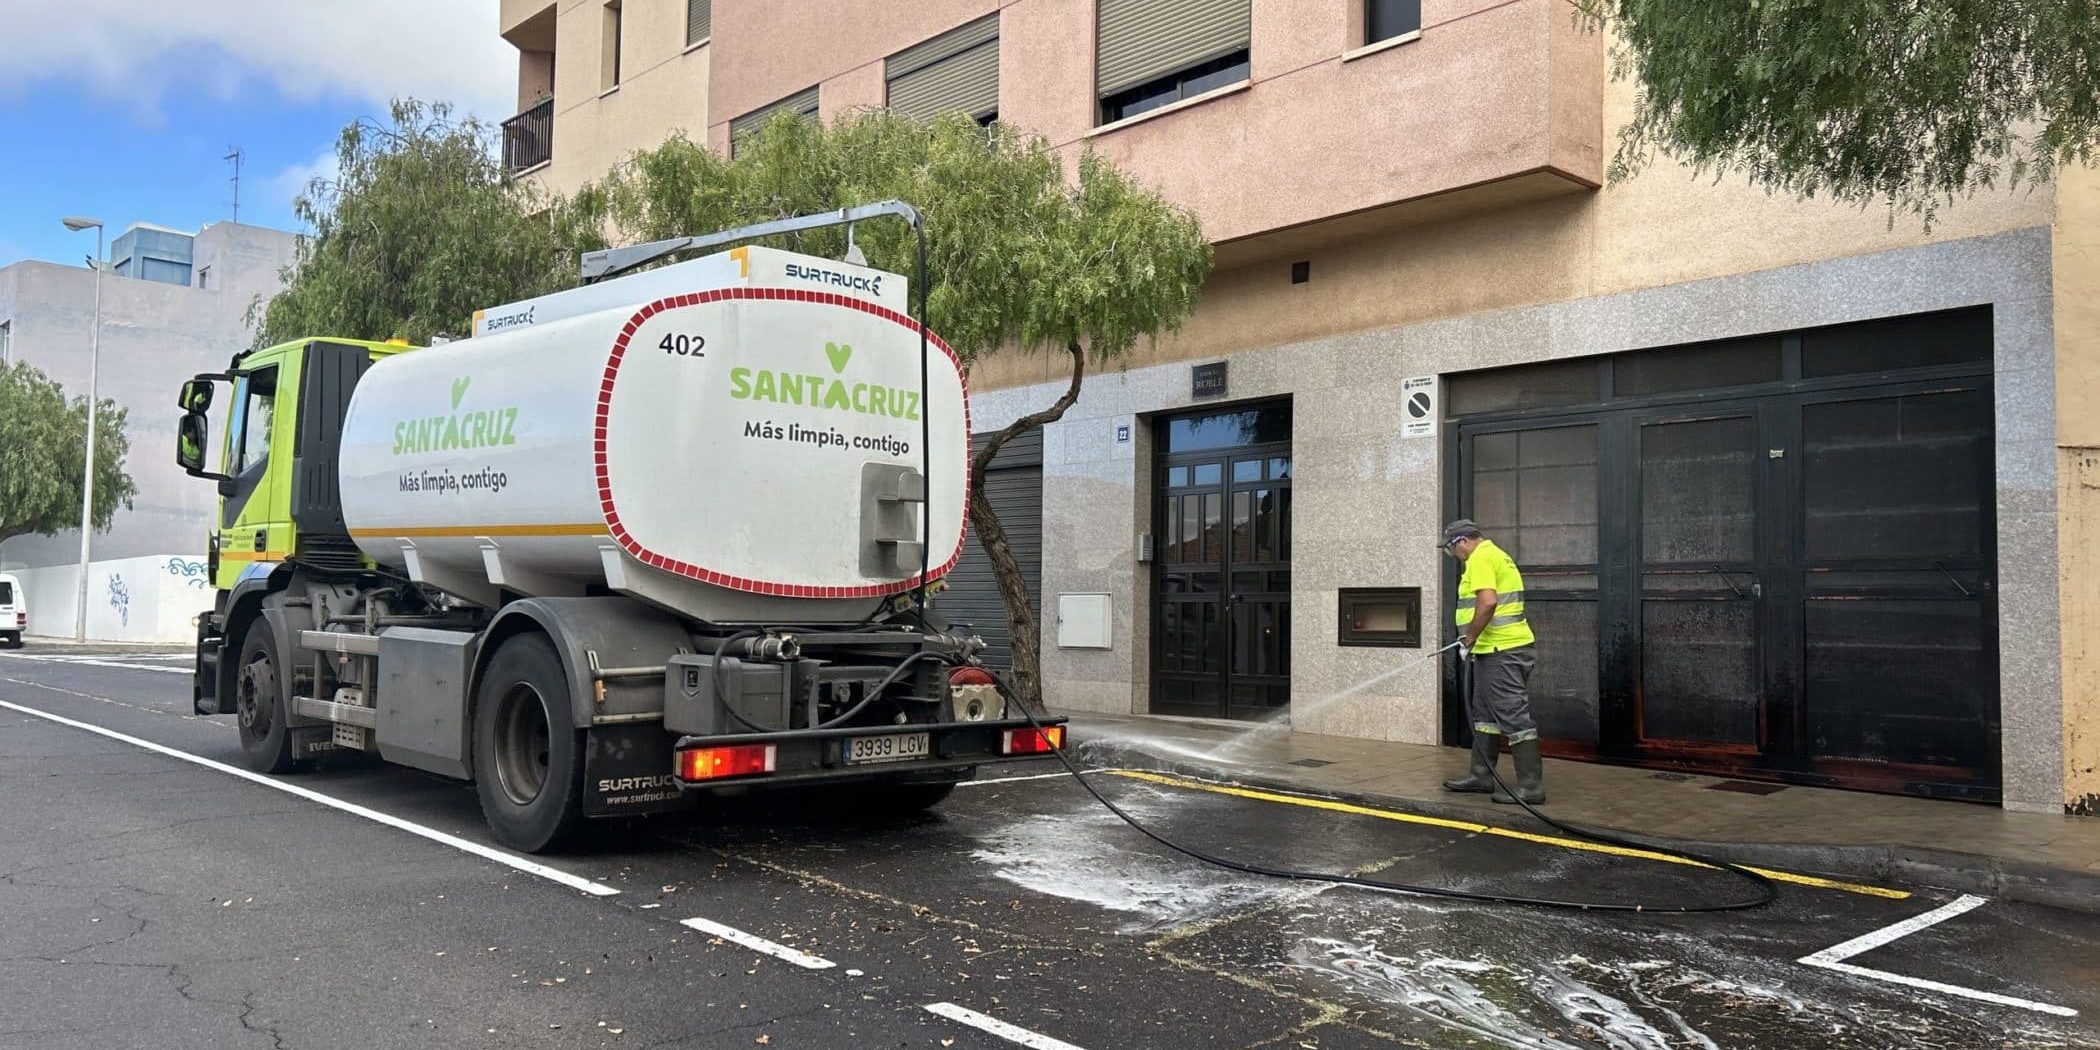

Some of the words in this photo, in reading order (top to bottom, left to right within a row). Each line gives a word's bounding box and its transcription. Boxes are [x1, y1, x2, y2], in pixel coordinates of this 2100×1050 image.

[786, 264, 871, 292] SURTRUCK
[487, 312, 528, 331] SURTRUCK
[659, 333, 705, 357] 402
[744, 420, 784, 440] Más
[788, 422, 849, 450] limpia,
[853, 435, 909, 457] contigo
[399, 471, 420, 492] Más
[421, 468, 460, 494] limpia,
[461, 466, 507, 493] contigo
[855, 738, 892, 757] 3939
[898, 735, 926, 754] LGV
[598, 774, 674, 792] SURTRUC
